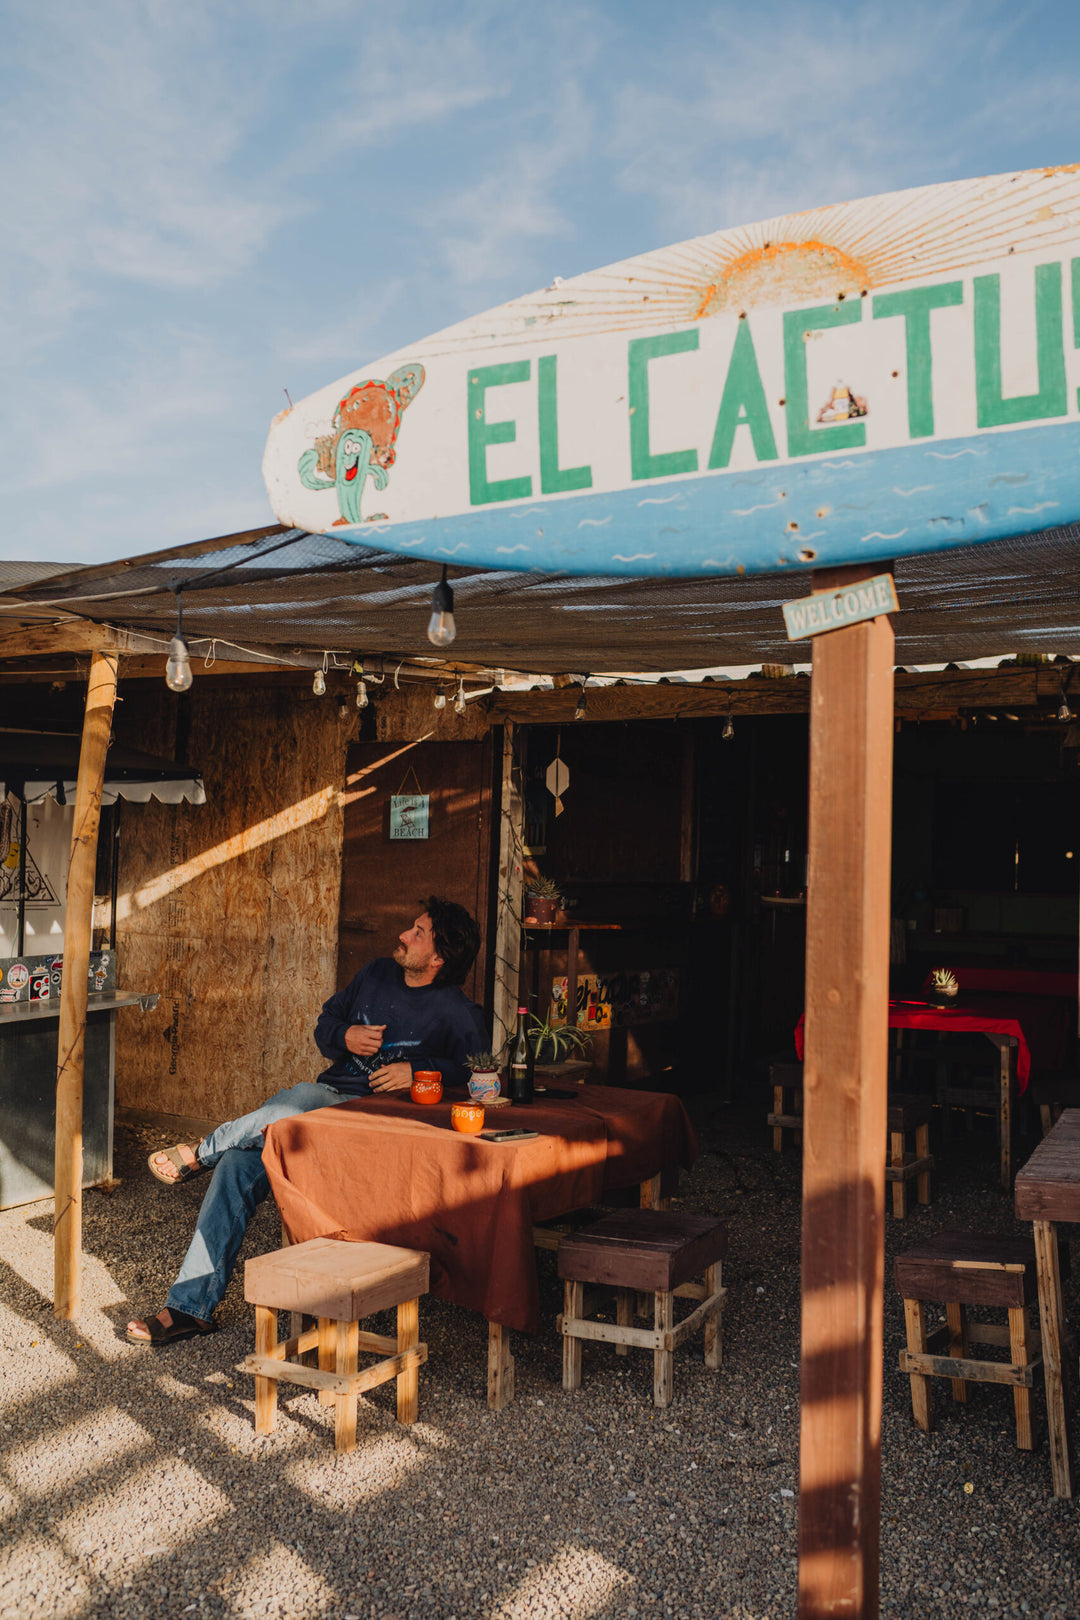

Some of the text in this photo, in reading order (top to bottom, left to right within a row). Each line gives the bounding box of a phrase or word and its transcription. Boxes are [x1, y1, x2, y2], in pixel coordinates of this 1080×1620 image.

[467, 256, 1080, 506] EL CACTU
[790, 582, 891, 631] WELCOME
[394, 828, 425, 837] BEACH
[168, 1000, 180, 1076] Georgia-Pacific
